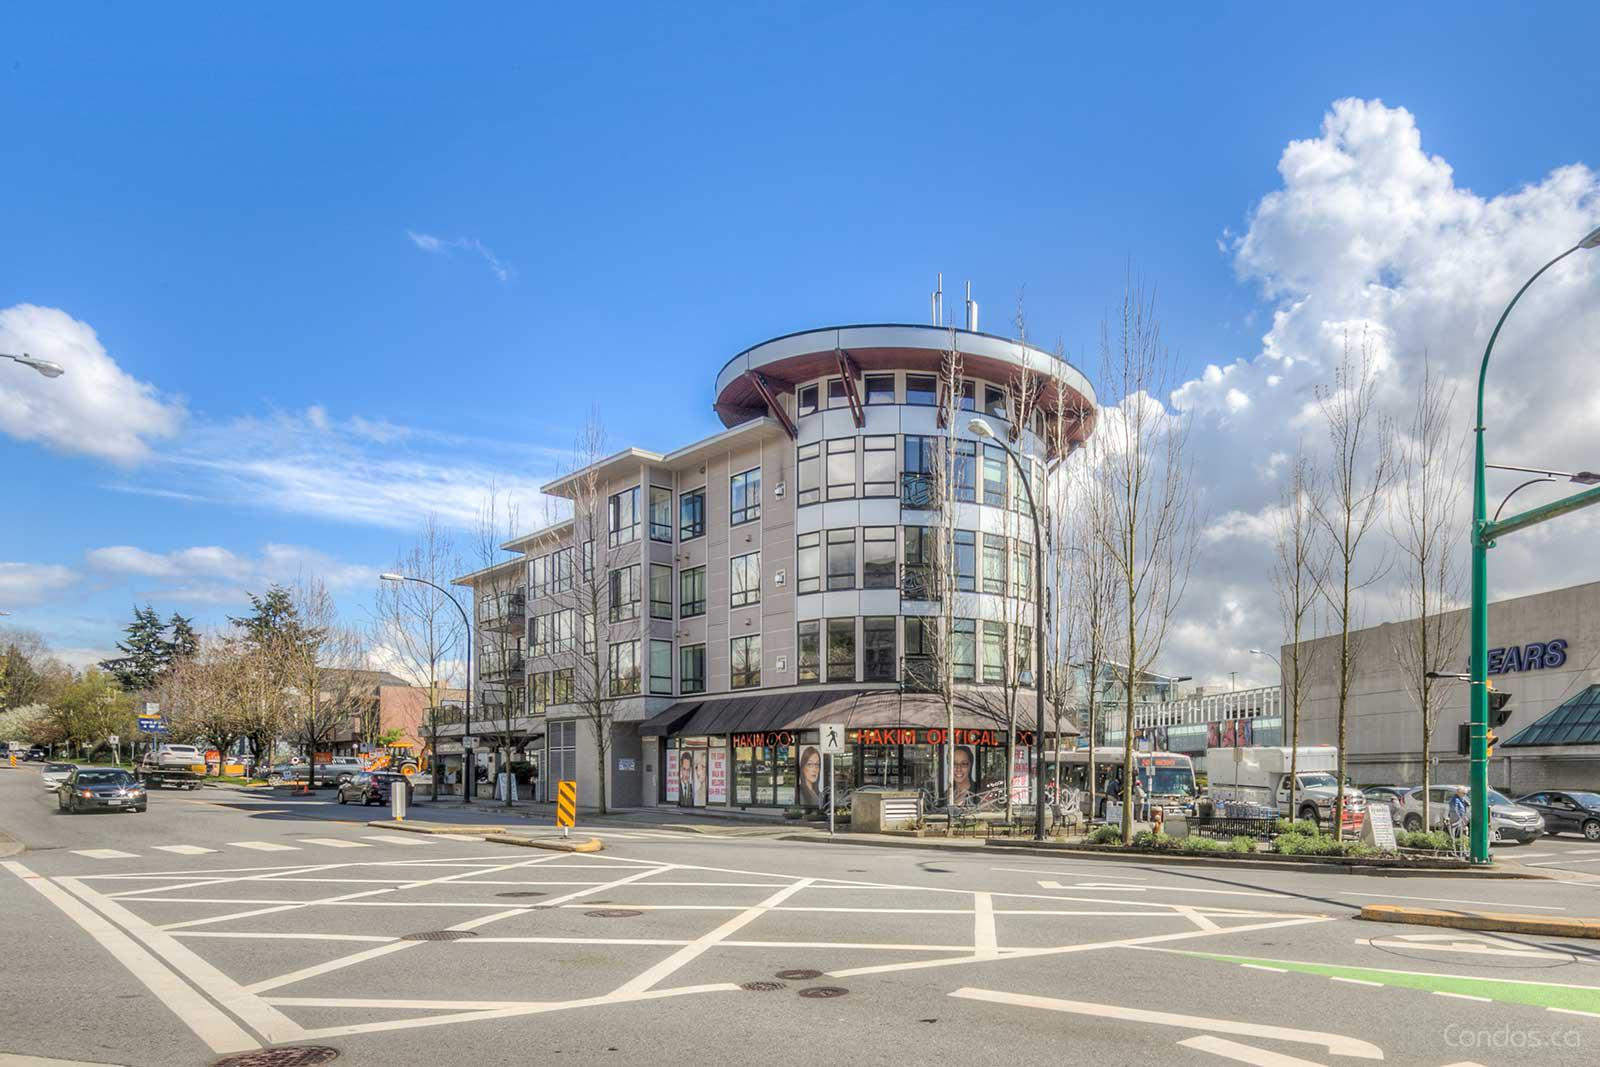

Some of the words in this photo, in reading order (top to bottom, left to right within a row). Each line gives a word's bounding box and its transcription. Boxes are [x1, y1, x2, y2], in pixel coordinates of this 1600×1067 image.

[1466, 639, 1568, 675] EARS
[732, 732, 765, 749] HAKIM
[857, 728, 916, 745] HAKIM
[927, 728, 999, 746] OPTICAL
